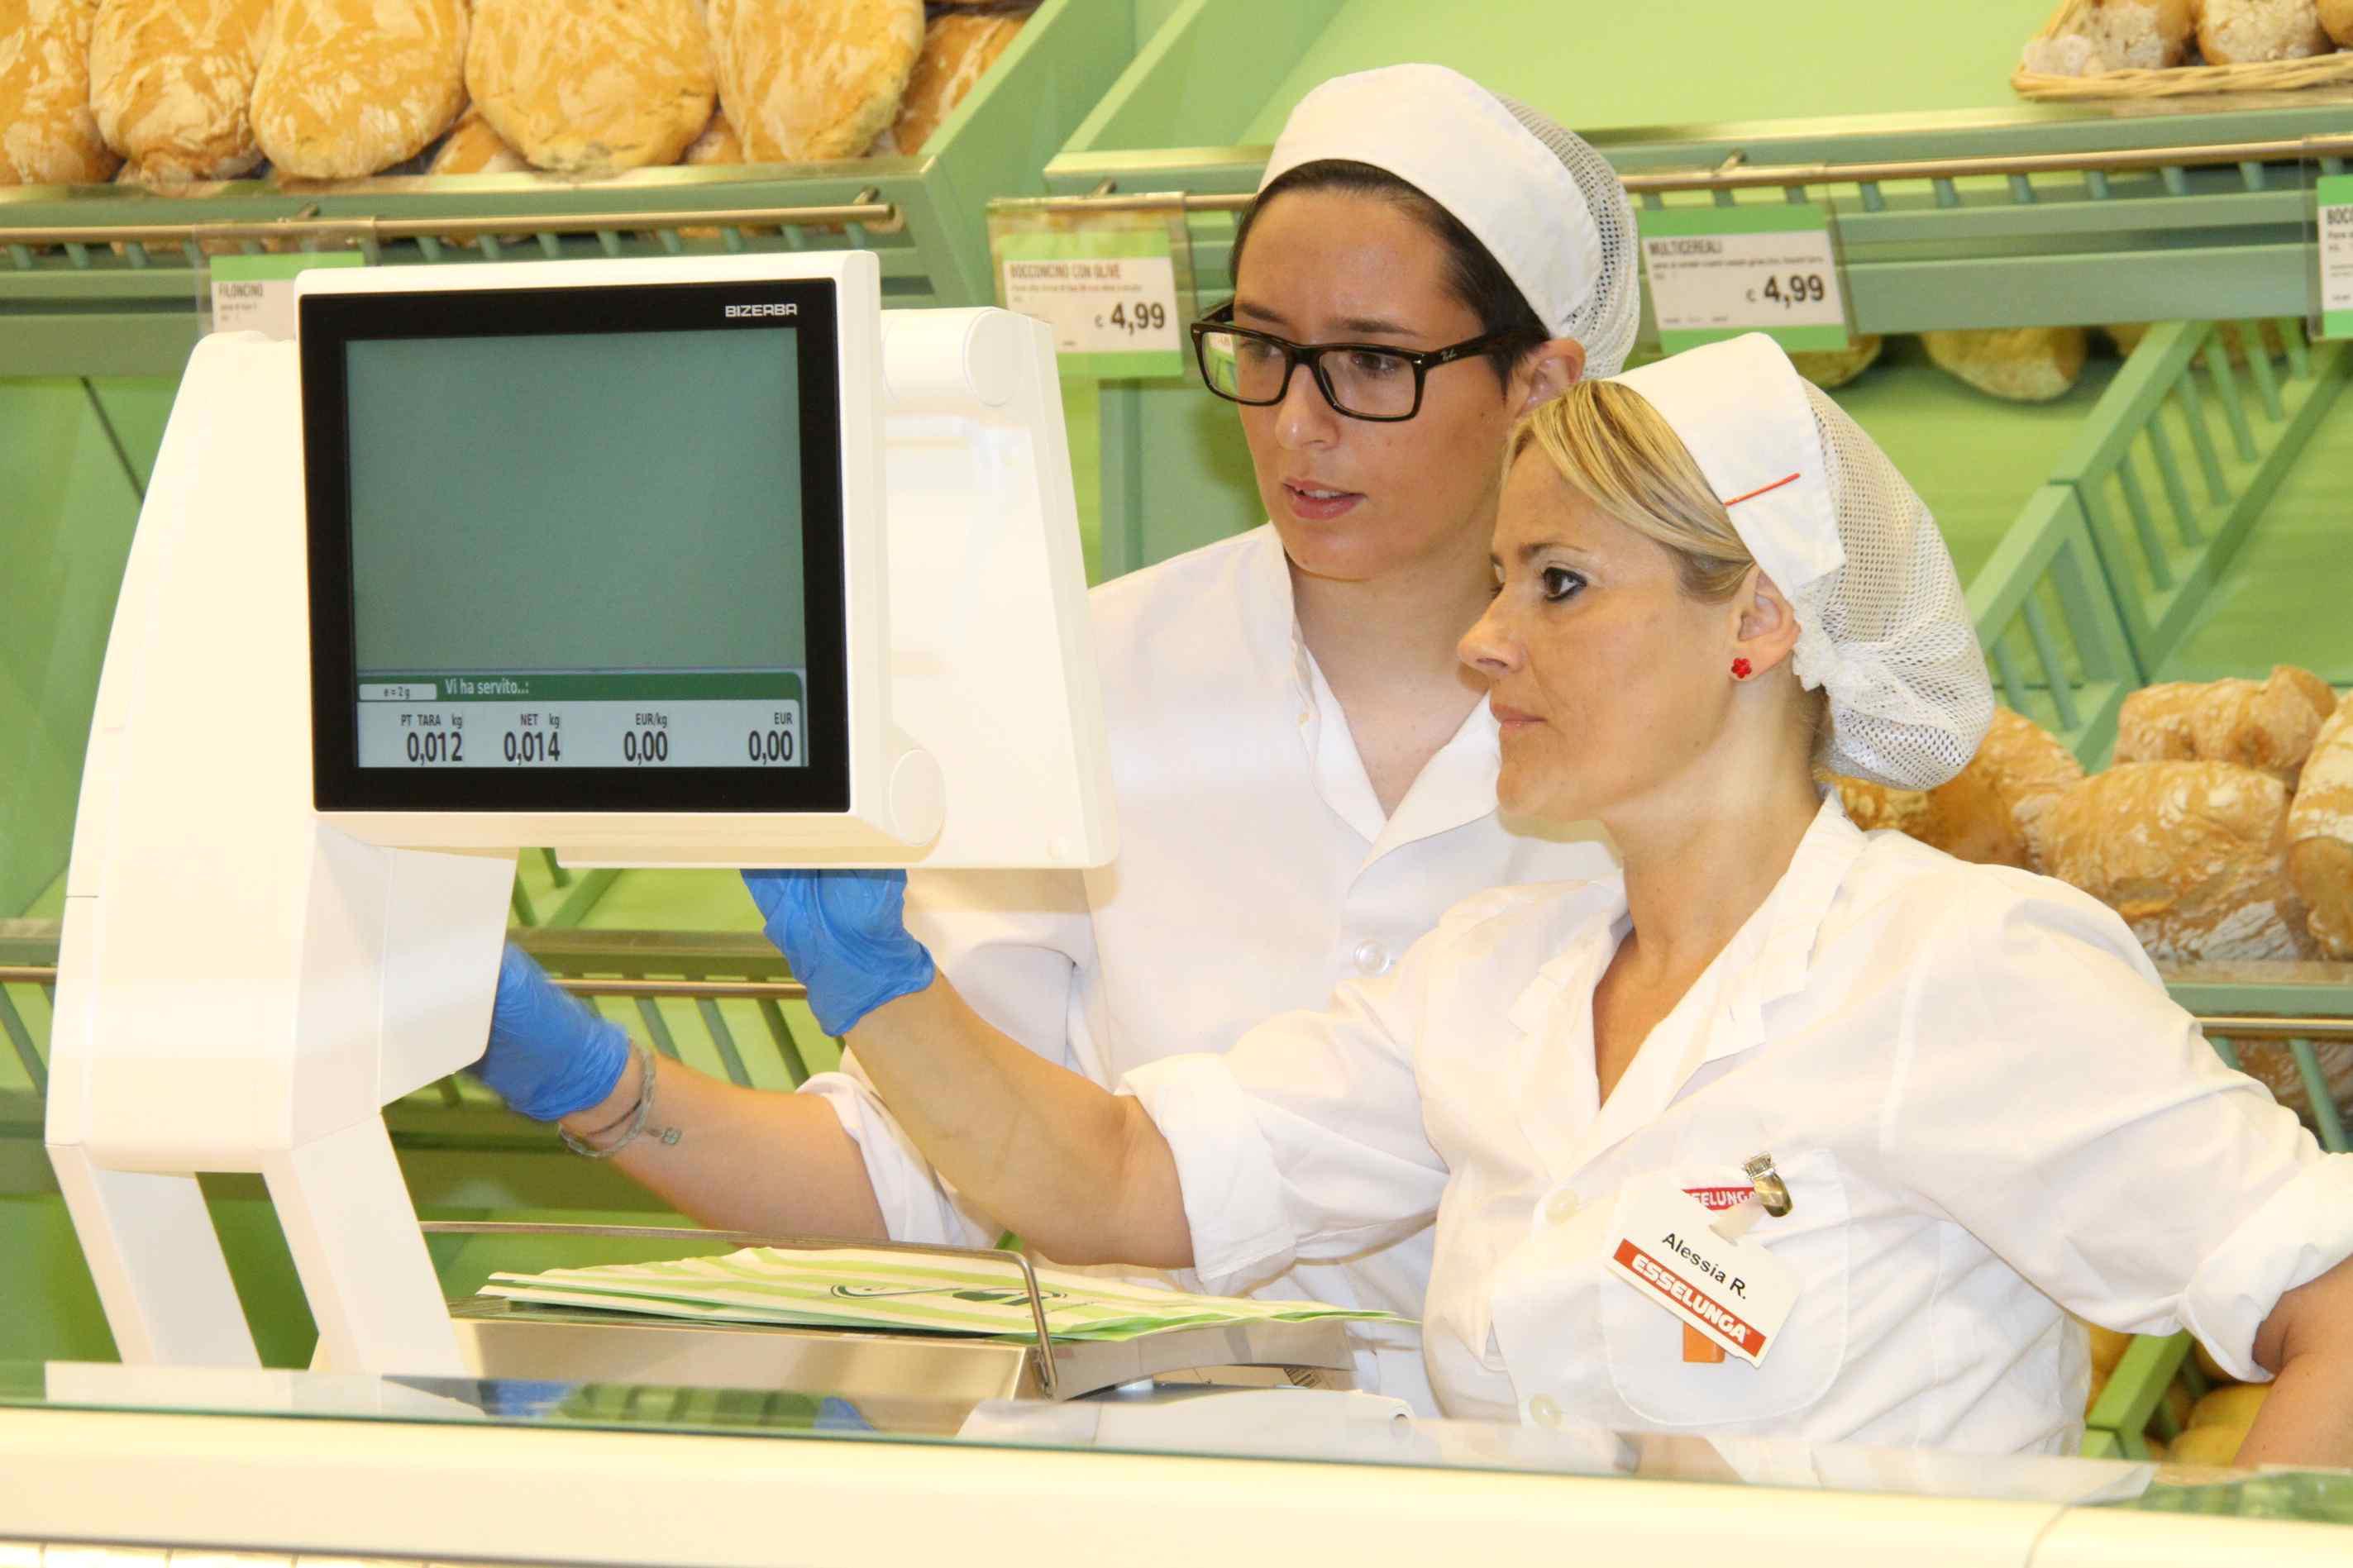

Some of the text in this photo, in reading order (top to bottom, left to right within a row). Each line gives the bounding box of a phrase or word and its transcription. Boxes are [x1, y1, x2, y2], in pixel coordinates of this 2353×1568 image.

[1649, 239, 1722, 257] MULTICEREALI
[219, 283, 265, 298] FILONCINO
[1764, 274, 1826, 309] 4,99
[725, 303, 798, 317] BIZERBA
[1110, 302, 1166, 336] 4,99
[445, 678, 457, 694] Vi
[460, 677, 475, 694] ha
[401, 713, 463, 729] PT TARA kg
[520, 713, 561, 729] NET kg
[635, 712, 668, 728] EUR/kg
[774, 712, 793, 725] EUR
[407, 731, 463, 765] 0,012
[504, 731, 561, 765] 0,014
[623, 730, 668, 765] 0,00
[748, 730, 793, 765] 0,00
[1662, 1232, 1746, 1299] Alessia R.
[1631, 1253, 1747, 1345] ESSELUNGA
